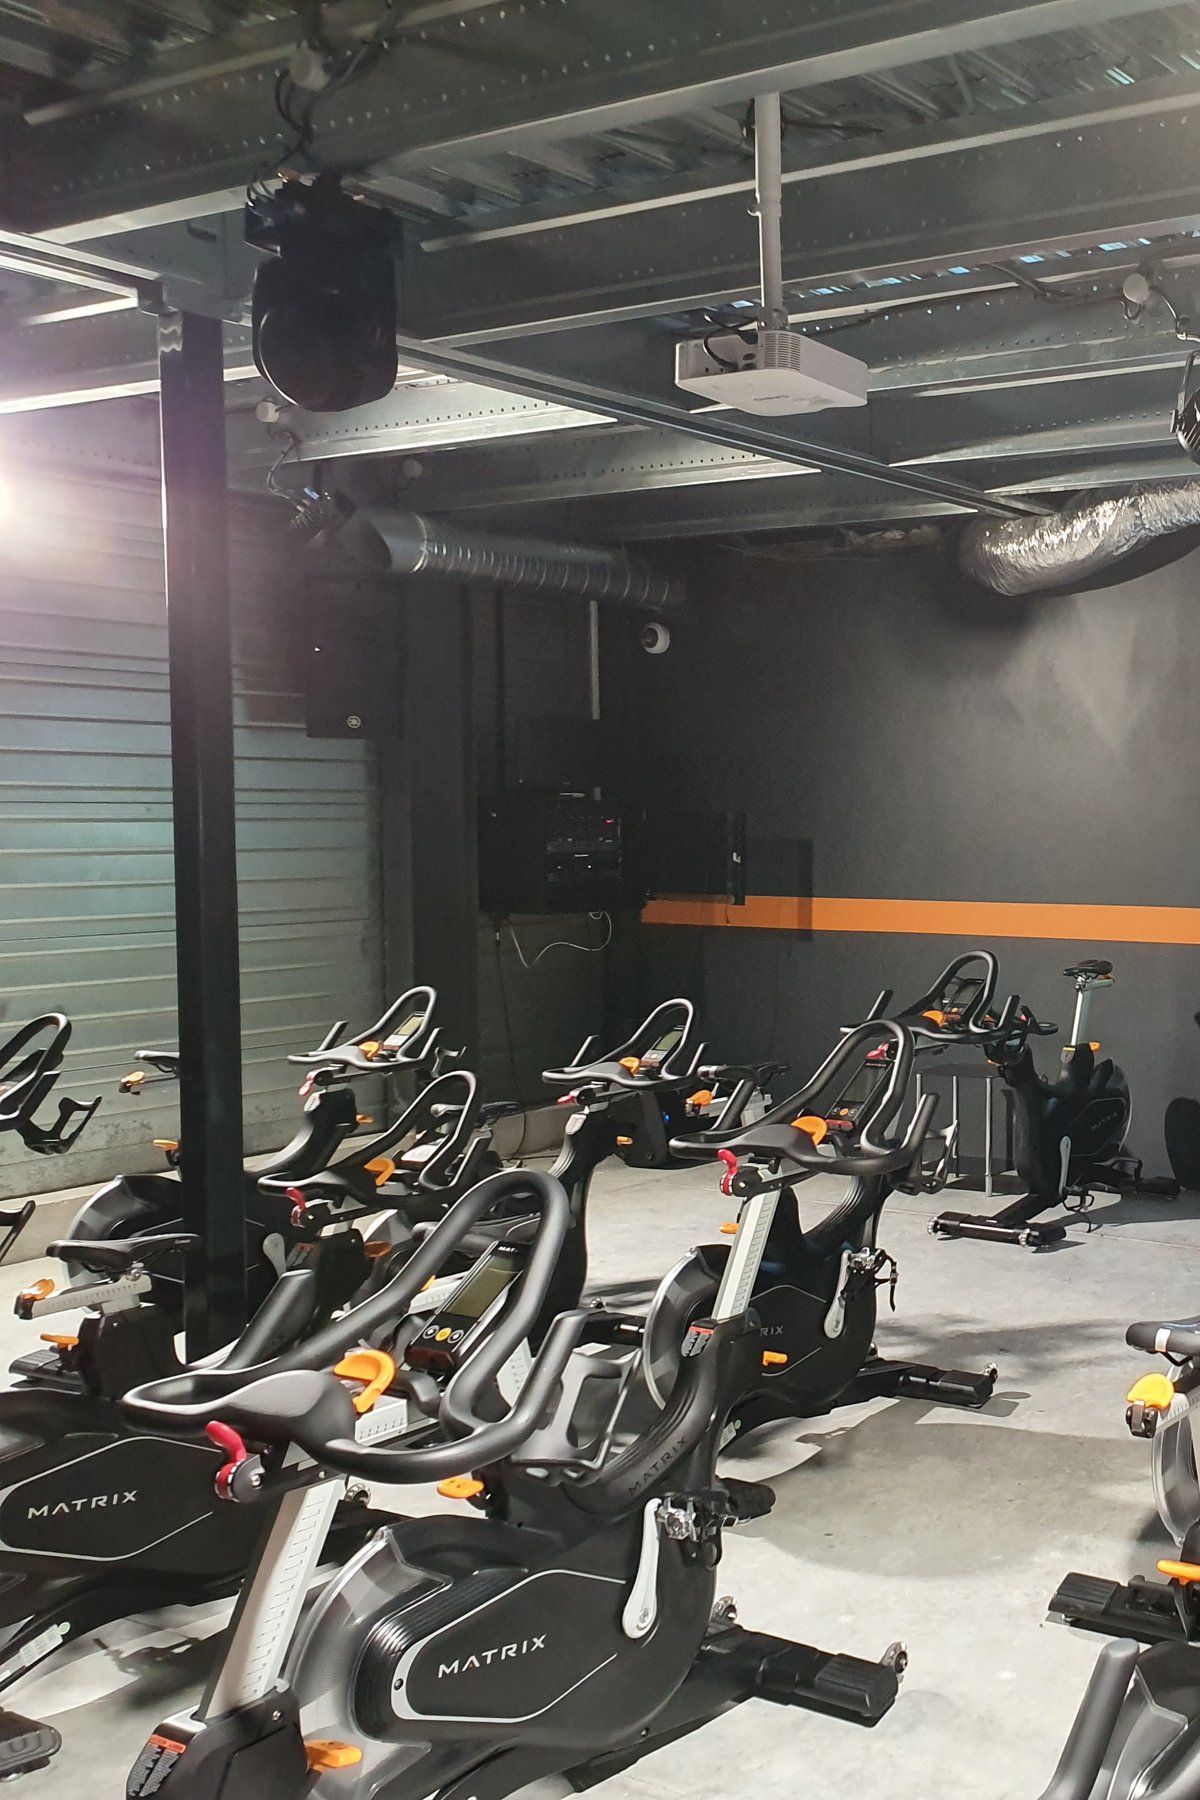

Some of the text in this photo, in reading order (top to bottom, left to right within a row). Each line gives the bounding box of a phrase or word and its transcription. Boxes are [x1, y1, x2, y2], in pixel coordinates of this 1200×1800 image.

[760, 1325, 784, 1337] RIX
[628, 1436, 686, 1492] MATRIX
[27, 1489, 138, 1520] MATRIX
[438, 1633, 547, 1679] MATRIX
